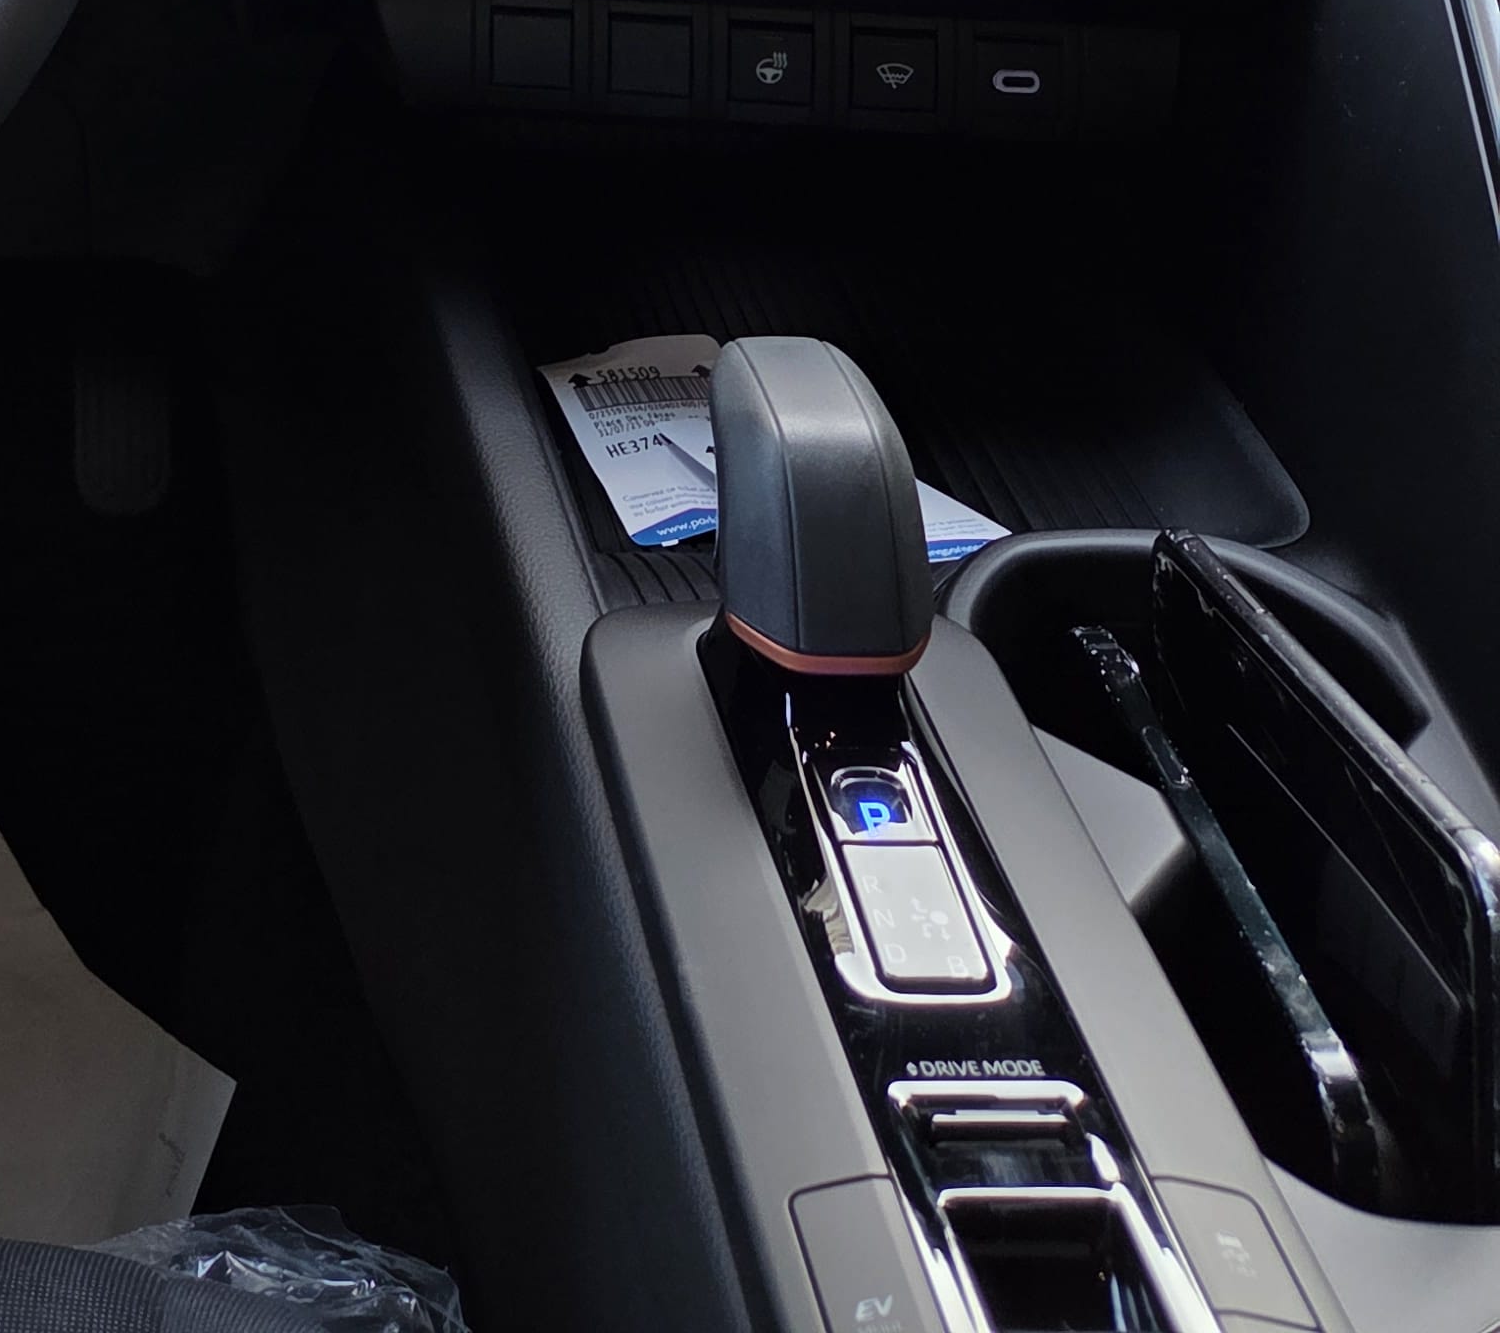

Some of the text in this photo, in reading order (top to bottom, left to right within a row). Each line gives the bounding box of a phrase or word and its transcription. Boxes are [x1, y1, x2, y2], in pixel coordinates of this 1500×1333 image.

[858, 802, 891, 839] P
[862, 875, 883, 894] R
[873, 908, 897, 928] N
[884, 943, 907, 964] D
[947, 955, 969, 976] B
[920, 1059, 1046, 1078] DRIVE MODE
[855, 1294, 893, 1322] EV
